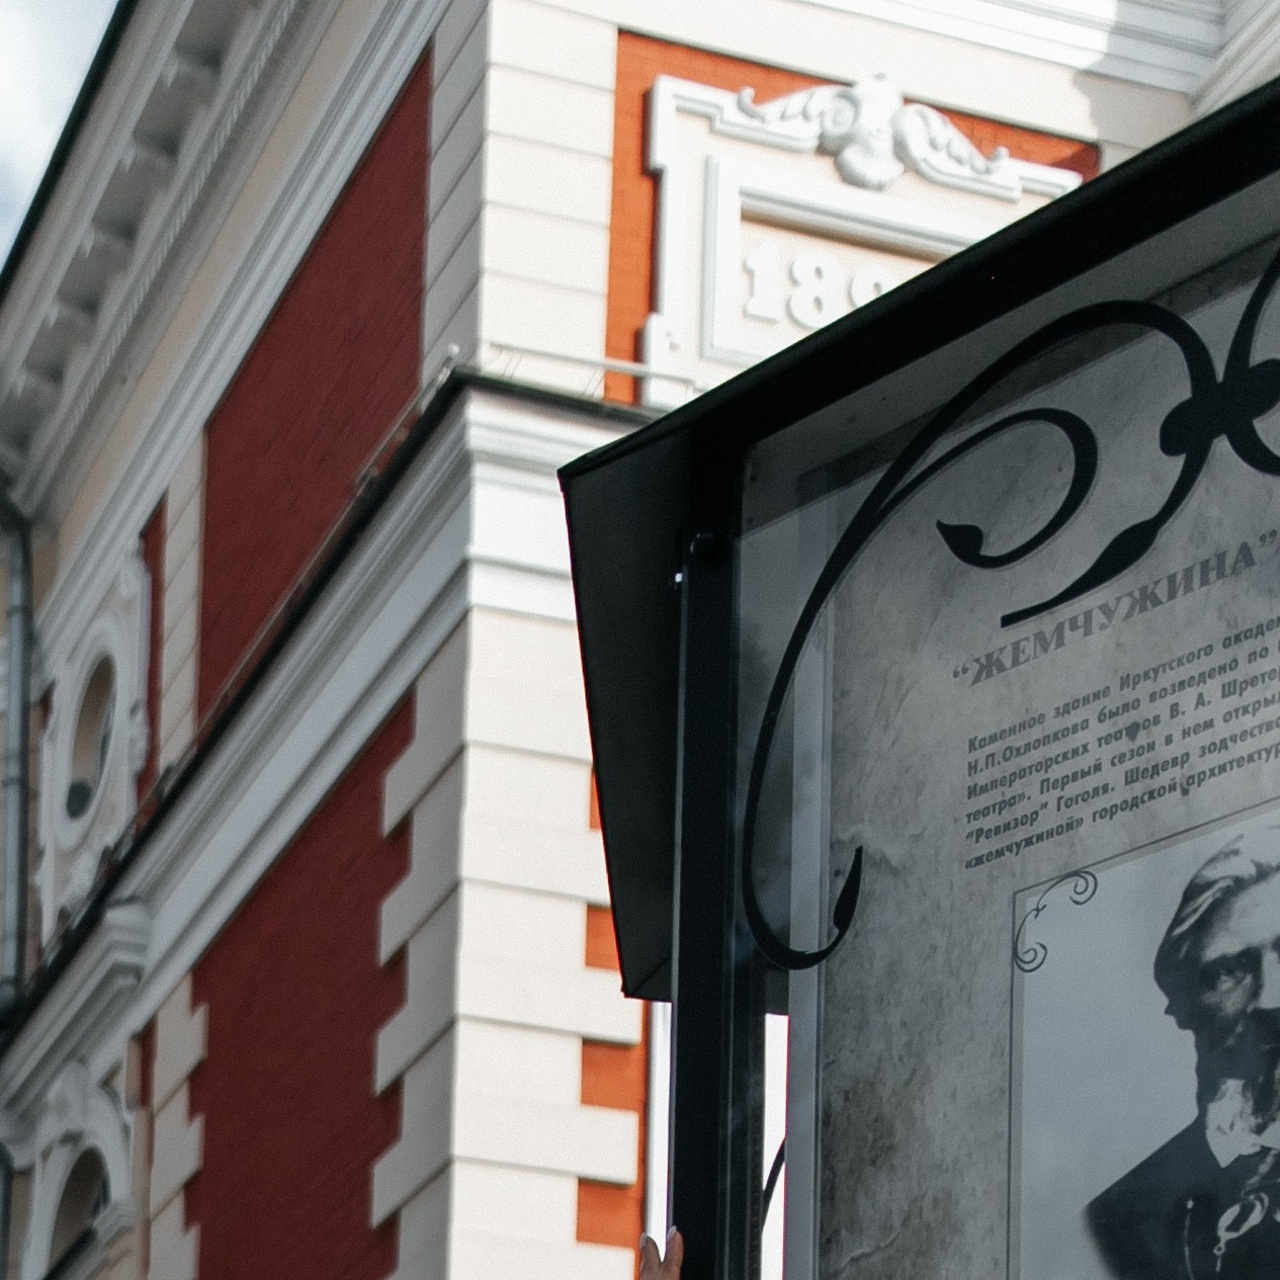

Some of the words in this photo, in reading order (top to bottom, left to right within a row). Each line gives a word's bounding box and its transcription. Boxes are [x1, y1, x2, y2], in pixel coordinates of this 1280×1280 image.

[967, 742, 1090, 800] Императорских
[1170, 702, 1186, 720] В.
[1194, 692, 1211, 711] А.
[968, 712, 1046, 754] Каменное
[1053, 686, 1111, 719] здание
[1120, 644, 1214, 691] Иркутского
[968, 718, 1090, 777] Н.П.Охлопкова
[1097, 697, 1141, 725] было
[1149, 657, 1239, 703] возведено
[1248, 646, 1269, 665] по
[965, 792, 1032, 824] театра».
[1040, 757, 1102, 795] Первый
[1110, 740, 1156, 768] сезон
[1165, 733, 1173, 747] в
[1182, 718, 1214, 740] нем
[965, 815, 1084, 870] «жемчужиной»
[1092, 777, 1177, 823] городской
[1057, 782, 1115, 812] Гоголя.
[1124, 751, 1190, 786] Шедевр
